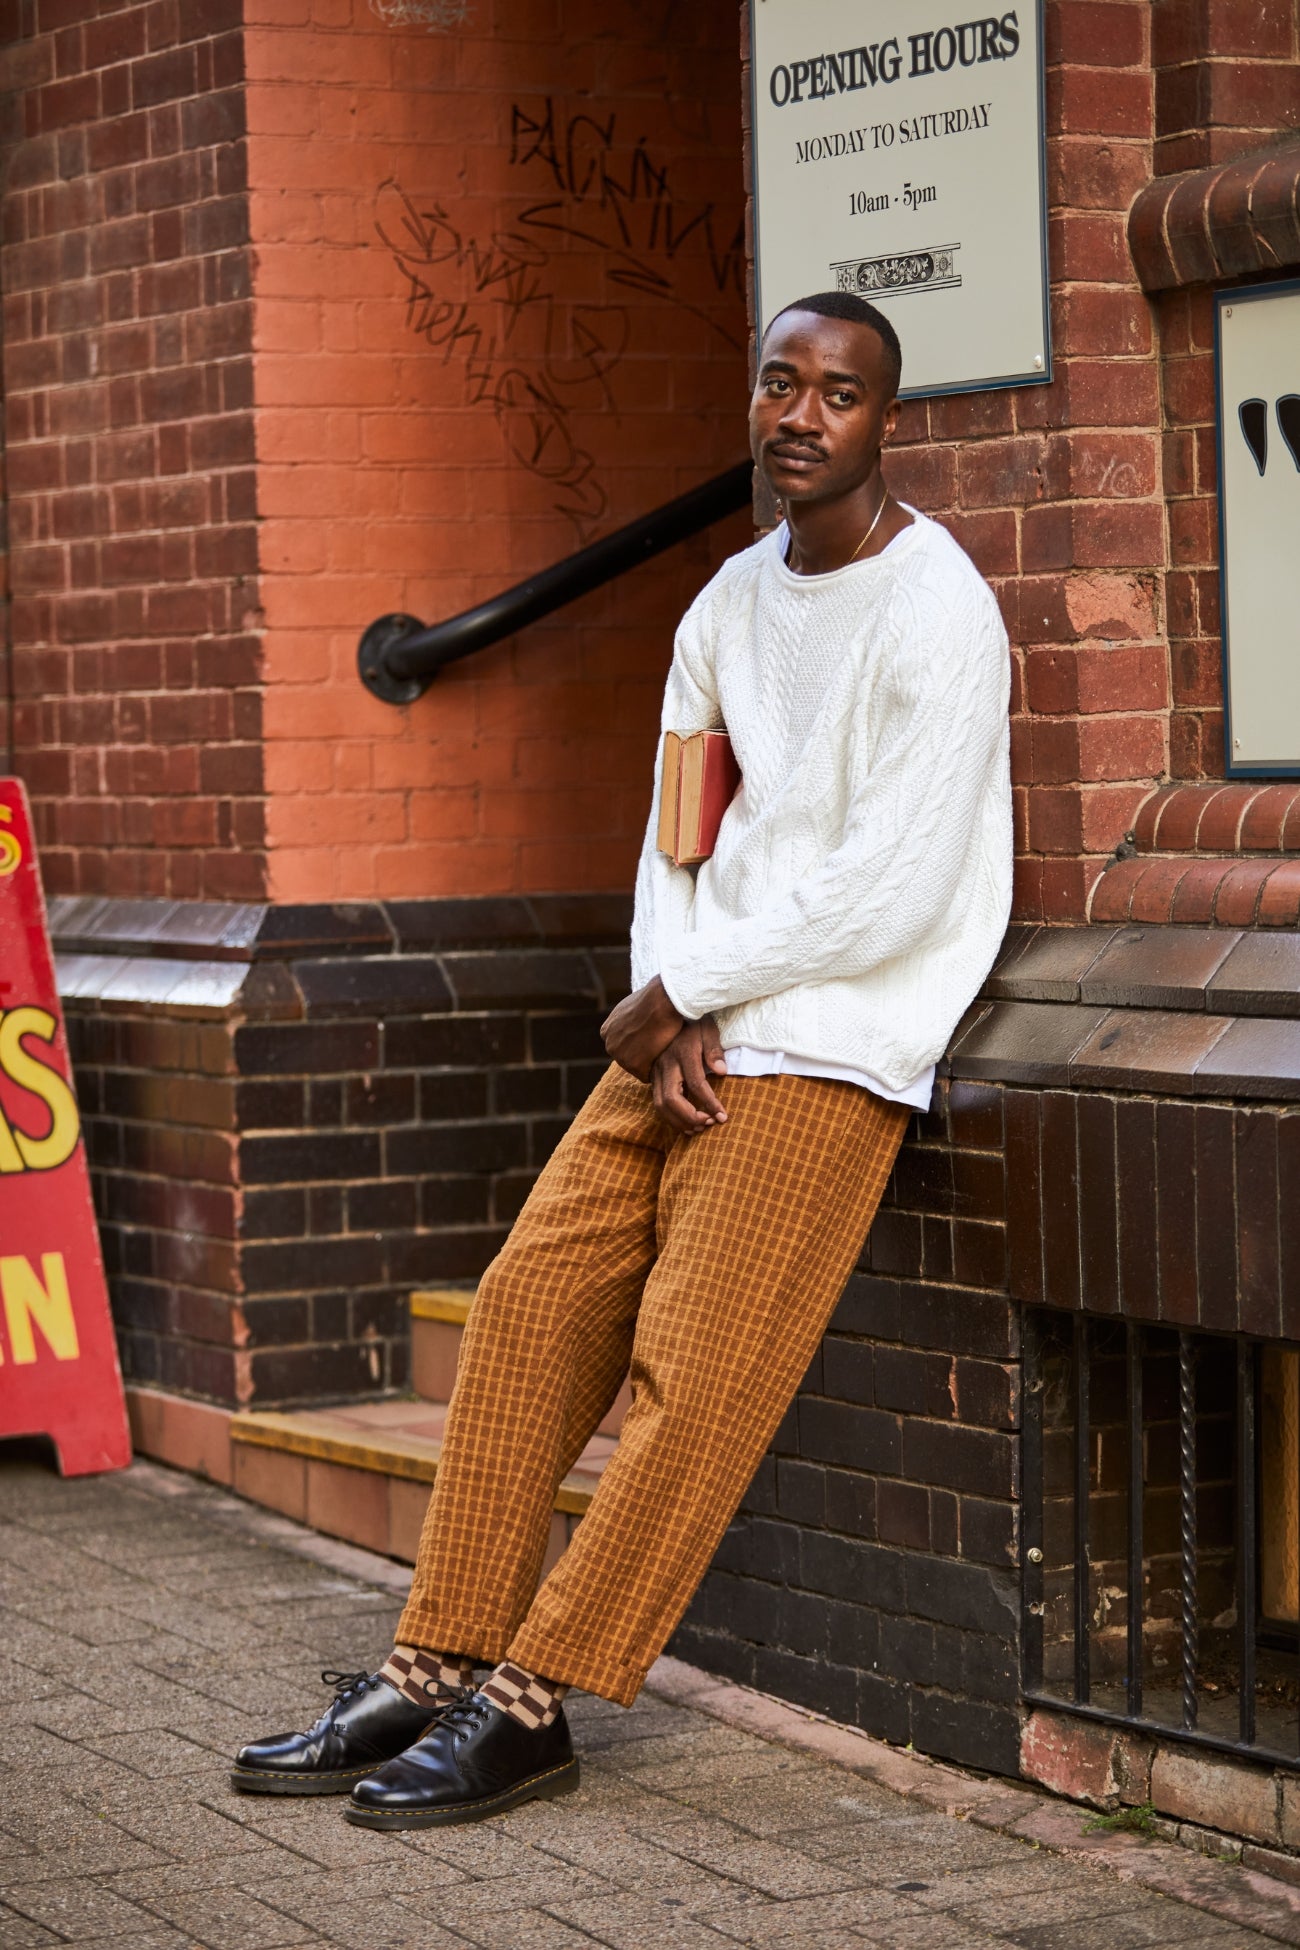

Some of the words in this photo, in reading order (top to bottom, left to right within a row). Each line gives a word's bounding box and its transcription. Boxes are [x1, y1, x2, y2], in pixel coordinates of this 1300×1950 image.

[769, 37, 903, 107] OPENING
[907, 10, 1020, 78] HOURS
[795, 128, 867, 164] MONDAY
[871, 123, 895, 149] TO
[899, 103, 992, 144] SATURDAY
[849, 190, 890, 216] 10am
[903, 182, 938, 211] 5pm
